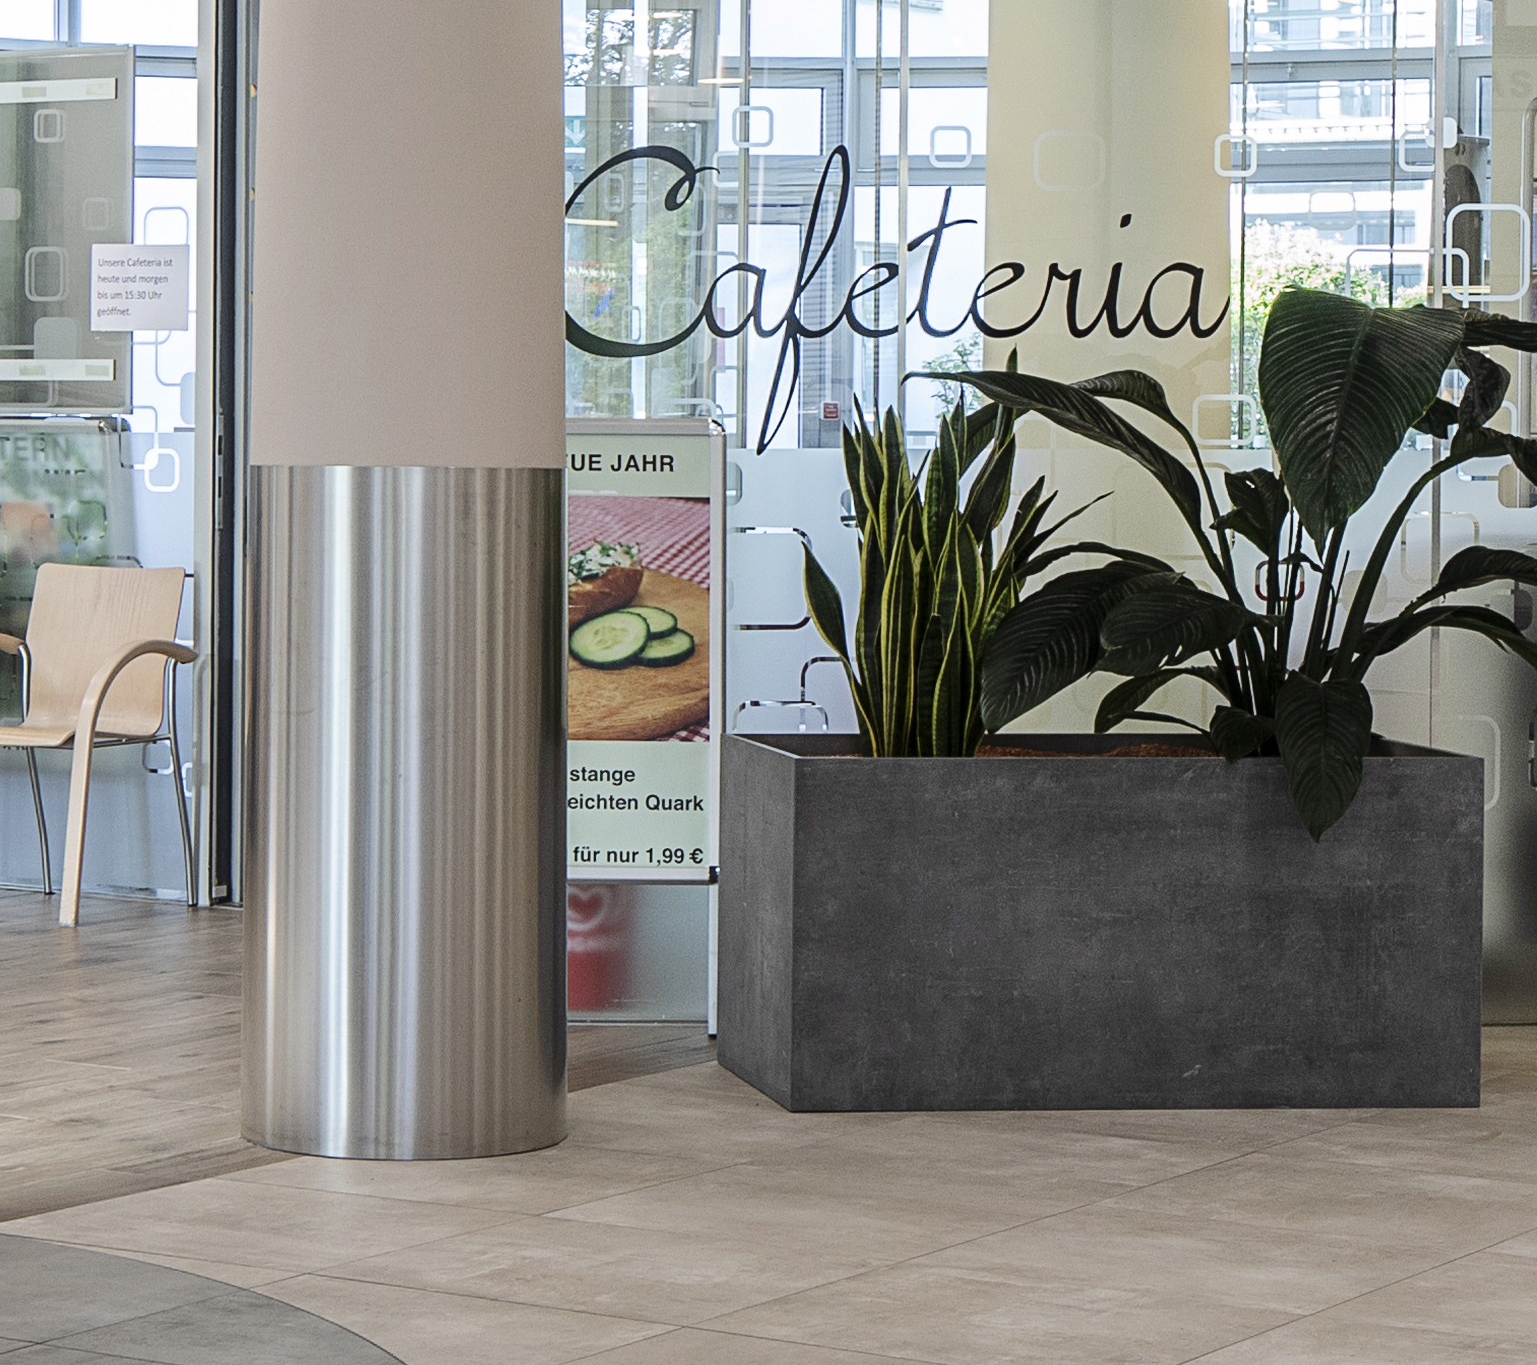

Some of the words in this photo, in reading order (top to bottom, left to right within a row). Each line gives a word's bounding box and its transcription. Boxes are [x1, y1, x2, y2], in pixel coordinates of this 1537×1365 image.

[98, 259, 125, 267] Unsere
[127, 258, 162, 267] Cafeteria
[163, 258, 173, 267] ist
[98, 275, 120, 283] heute
[122, 275, 137, 283] und
[138, 276, 168, 285] morgen
[97, 291, 108, 299] bis
[125, 291, 146, 300] 15:30
[148, 291, 162, 300] Uhr
[566, 144, 1230, 455] Cafeteria
[97, 307, 131, 317] geöffnet.
[566, 454, 602, 471] UE
[610, 454, 674, 472] JAHR
[569, 767, 636, 786] stange
[646, 794, 704, 811] Quark
[573, 846, 601, 862] für
[607, 850, 639, 863] nur
[646, 848, 684, 866] 1,99
[689, 848, 704, 864] €
